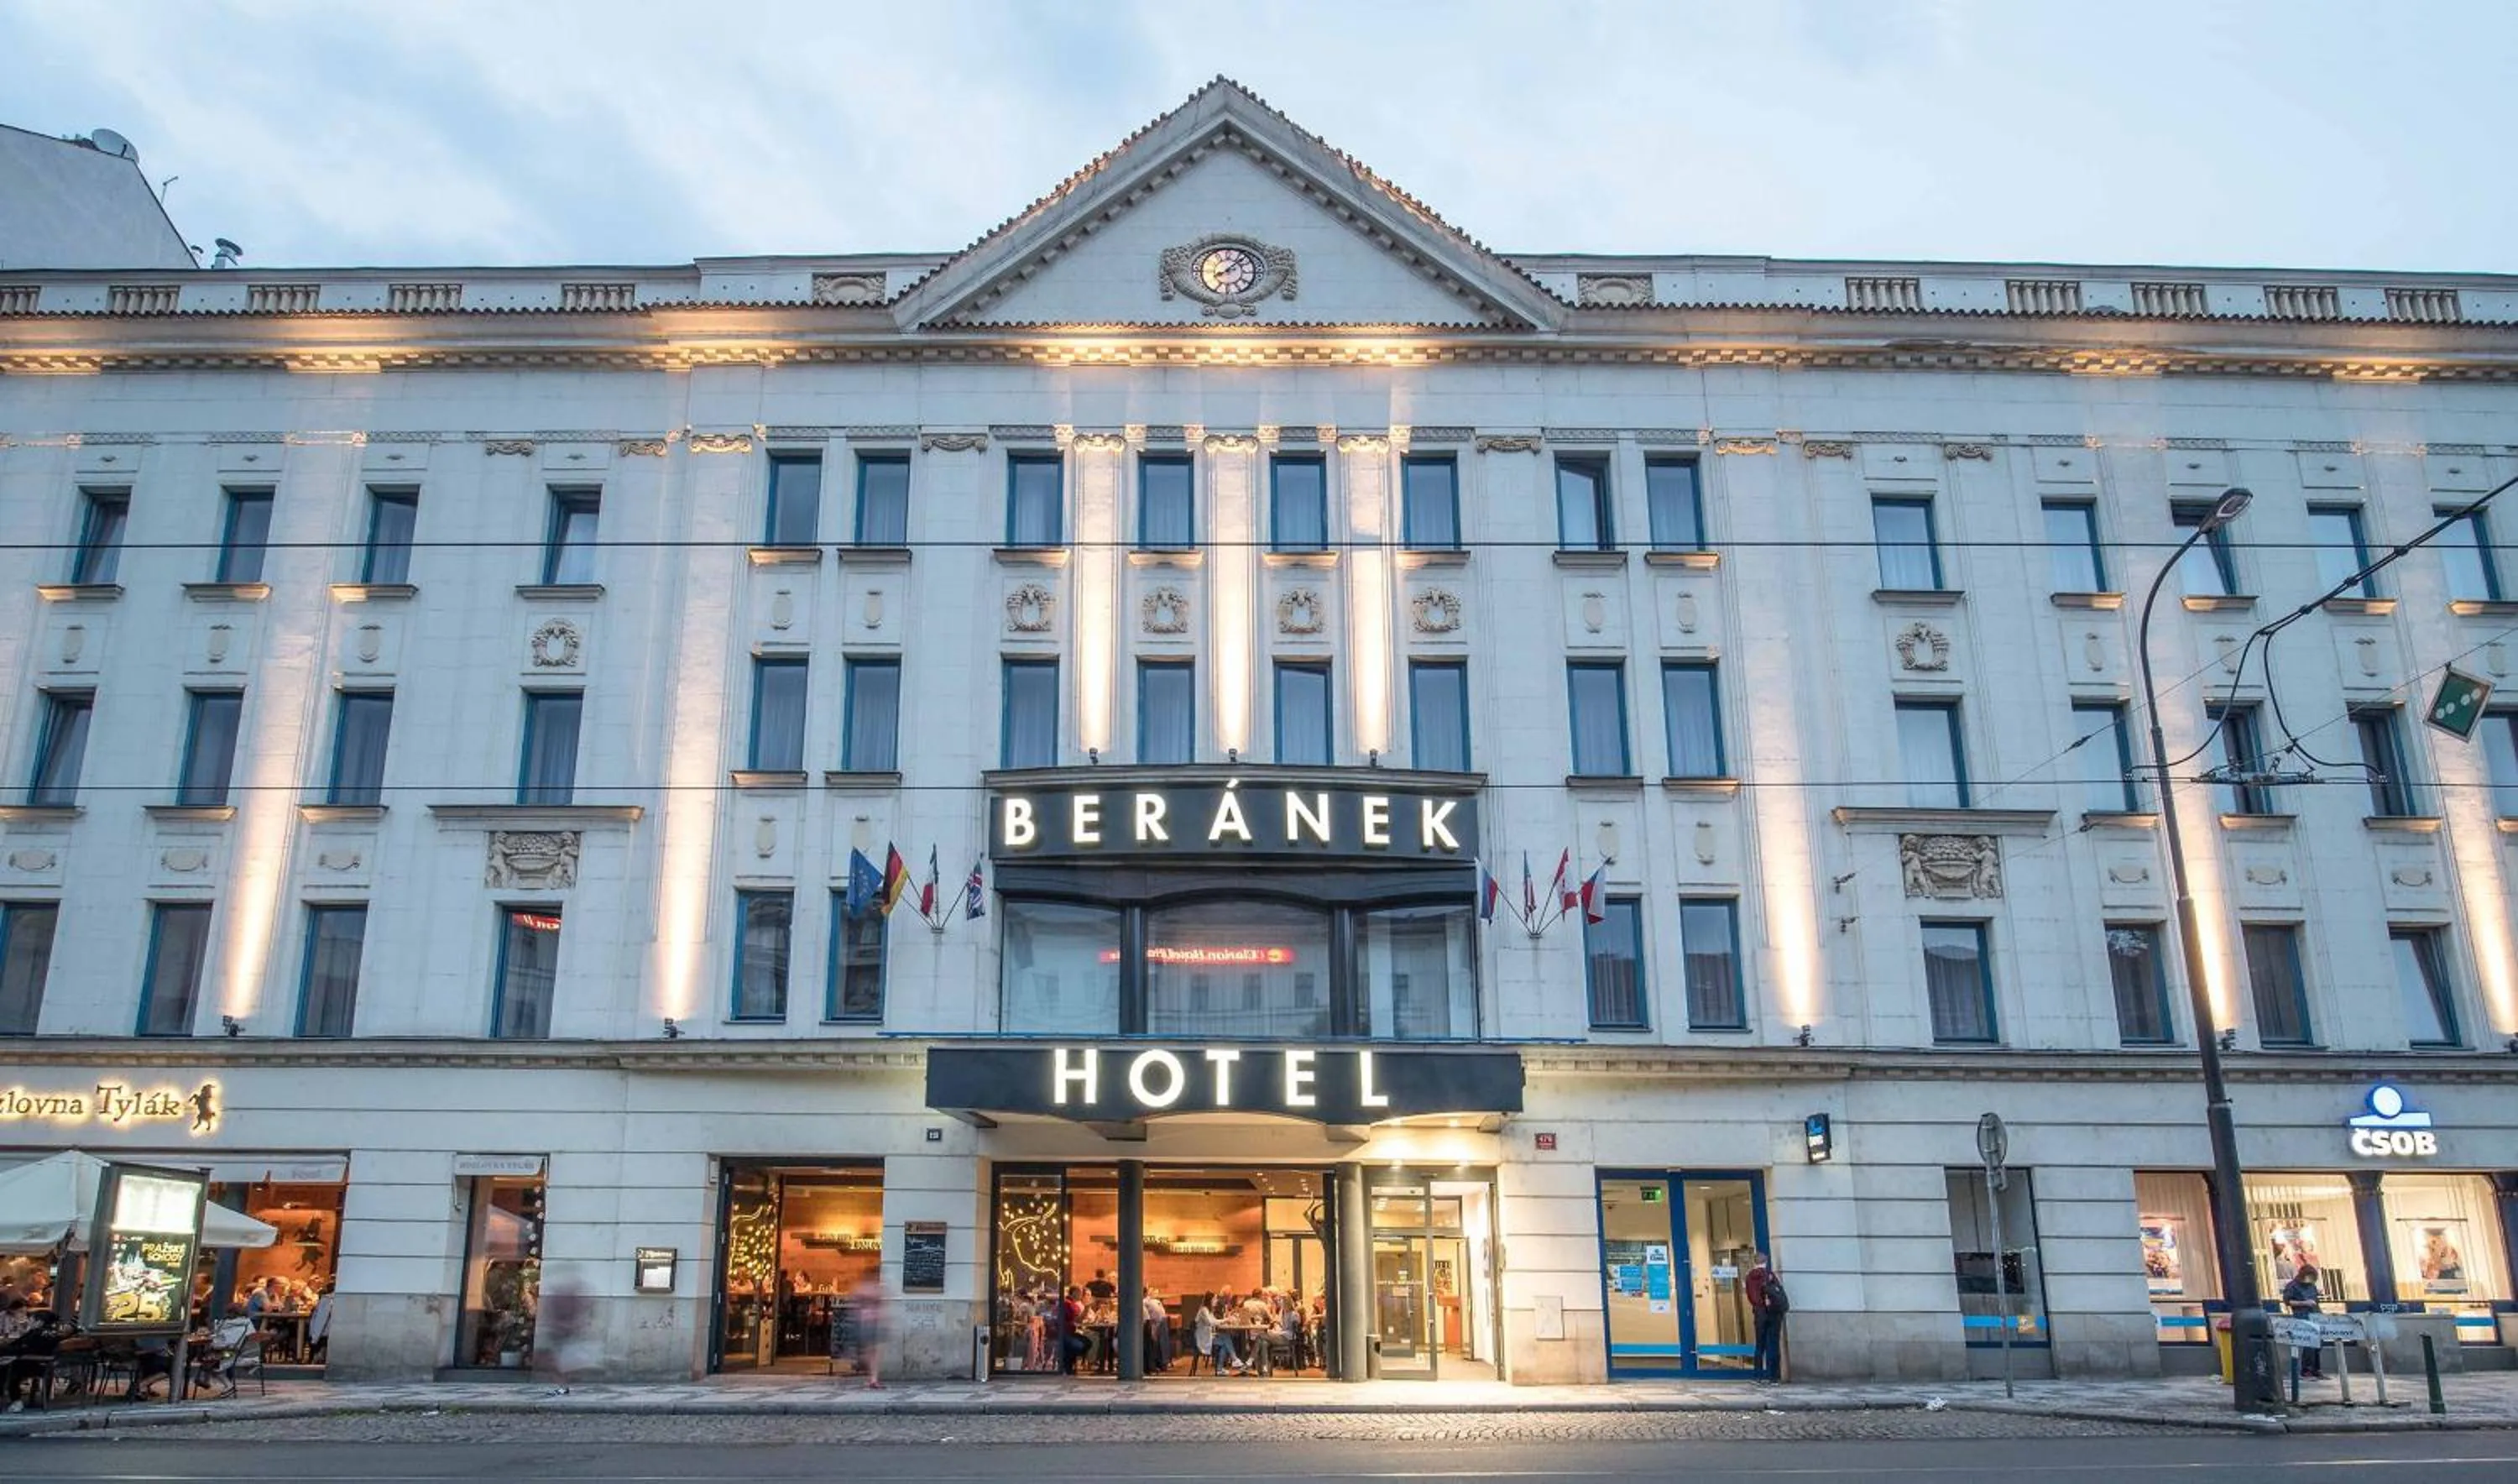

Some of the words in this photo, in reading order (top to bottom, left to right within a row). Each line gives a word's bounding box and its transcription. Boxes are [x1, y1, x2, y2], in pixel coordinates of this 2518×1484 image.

[1005, 778, 1460, 848] BERÁNEK
[1053, 1048, 1389, 1107] HOTEL
[96, 1084, 180, 1122] Tylák
[2352, 1128, 2437, 1156] ČSOB
[112, 1291, 163, 1321] 25
